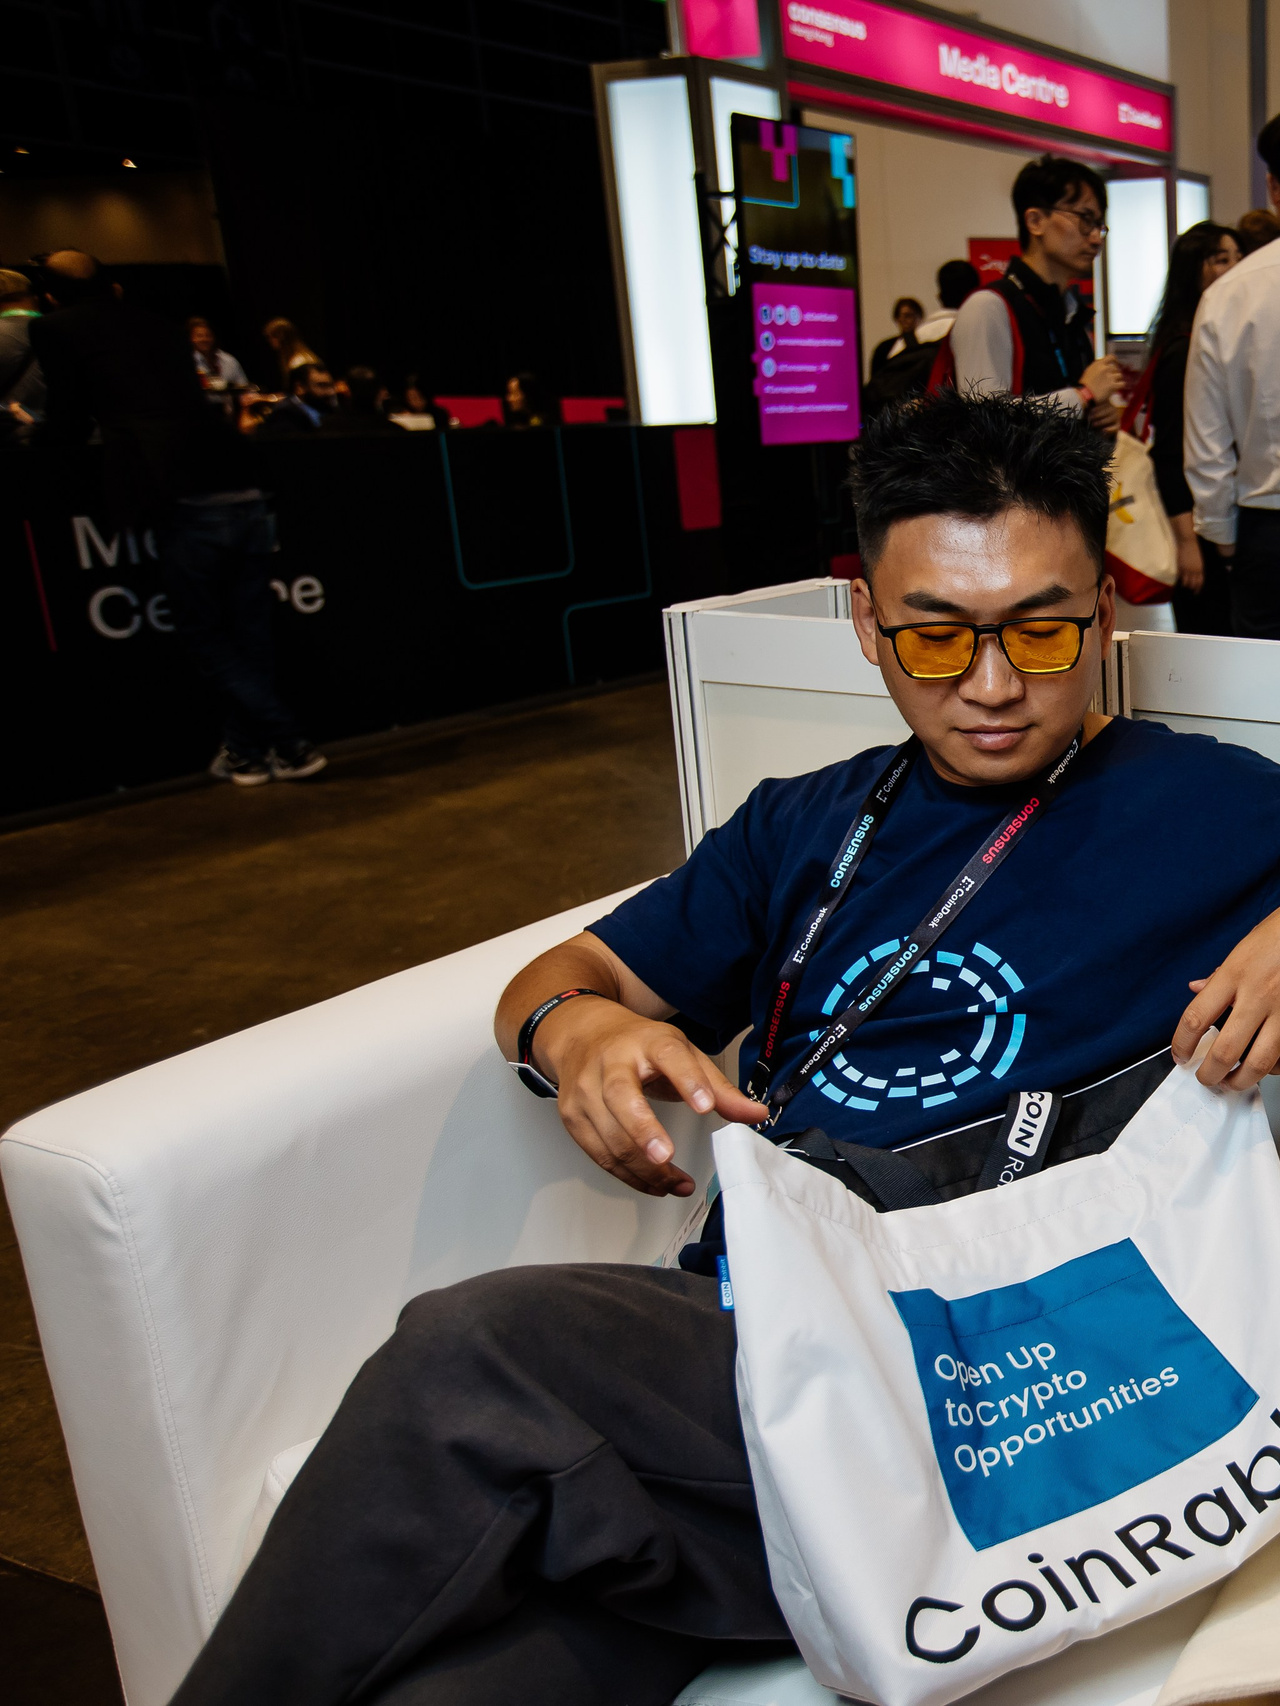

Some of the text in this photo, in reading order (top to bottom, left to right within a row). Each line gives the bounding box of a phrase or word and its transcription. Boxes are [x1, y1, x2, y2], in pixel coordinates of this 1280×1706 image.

[938, 43, 1070, 108] Media Centre
[801, 906, 828, 950] CoinDesk
[882, 758, 909, 793] CoinDesk
[928, 888, 965, 928] CoinDesk
[800, 1035, 836, 1075] CoinDesk
[934, 1353, 1005, 1392] Open
[945, 1370, 1087, 1427] to Crypto
[954, 1366, 1180, 1478] Opportunities
